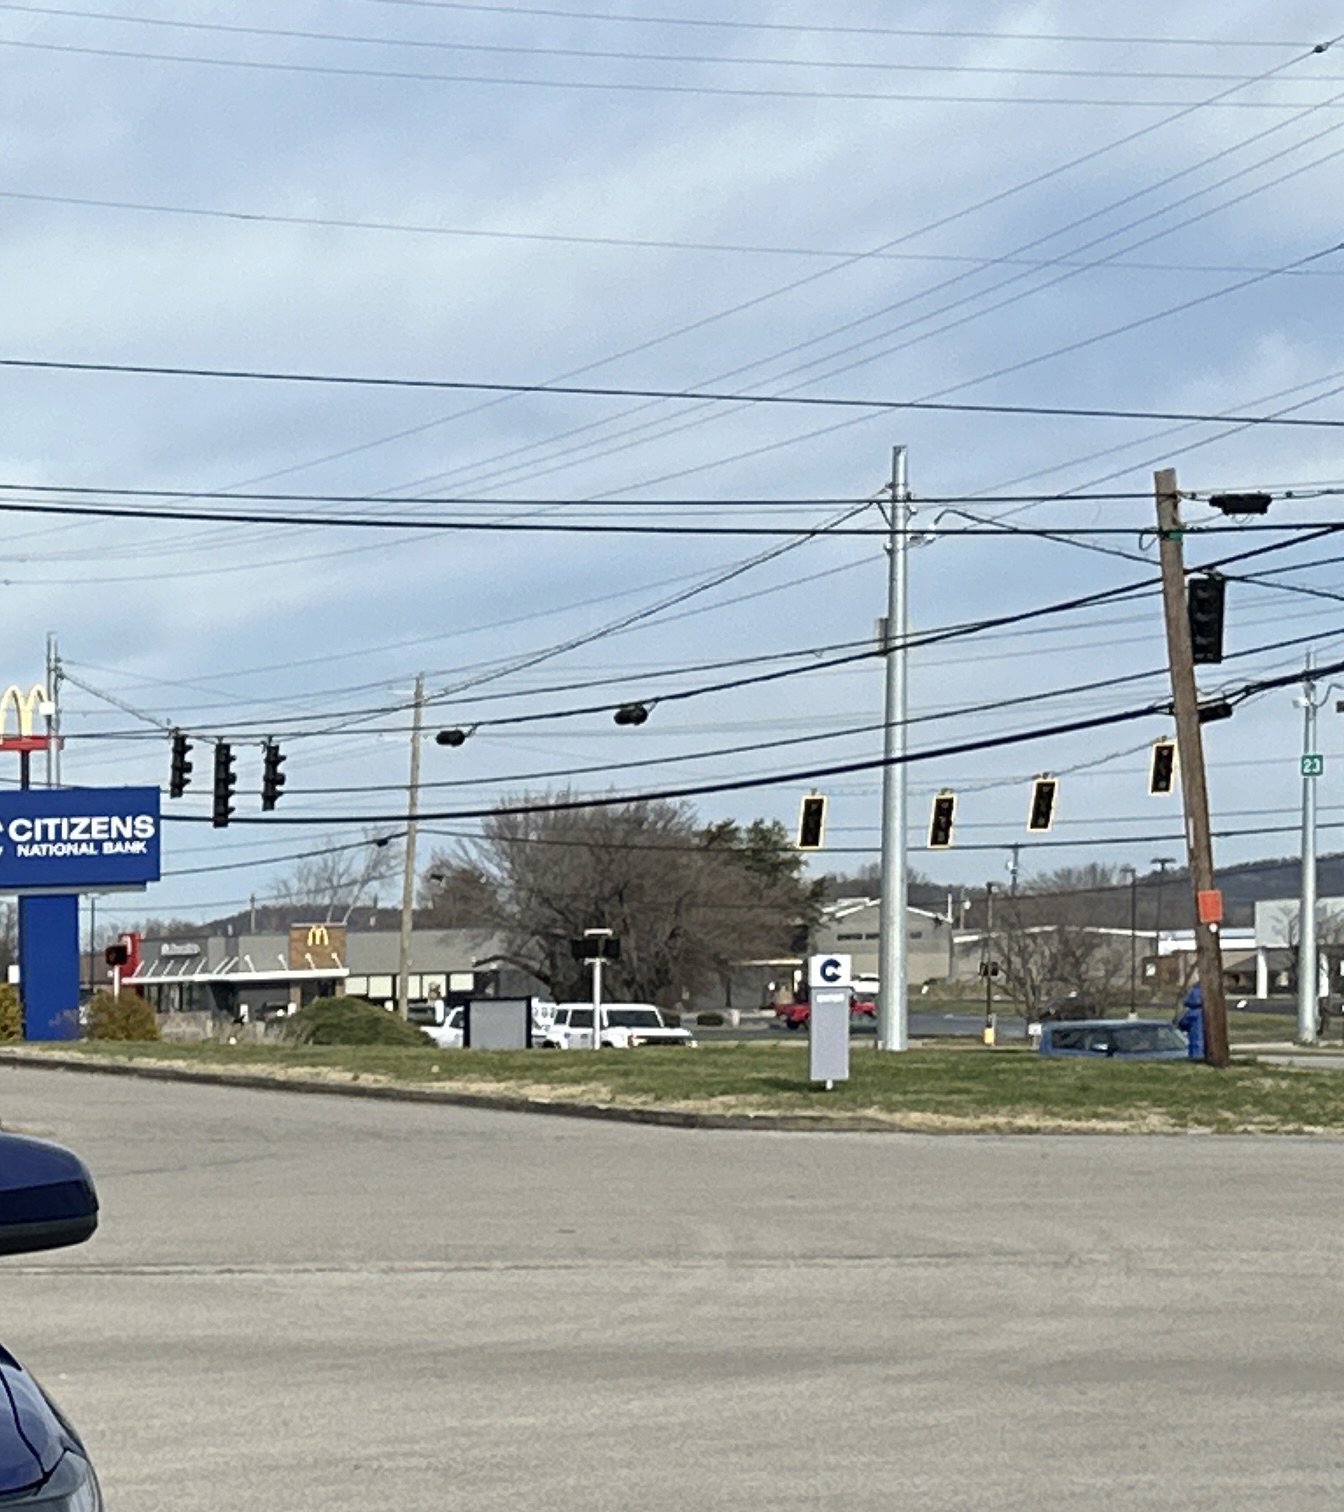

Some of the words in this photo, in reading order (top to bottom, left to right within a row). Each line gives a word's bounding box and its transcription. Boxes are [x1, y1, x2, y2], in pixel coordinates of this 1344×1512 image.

[8, 814, 156, 842] CITIZENS
[17, 842, 99, 858] NATIONAL
[102, 840, 147, 855] BANK
